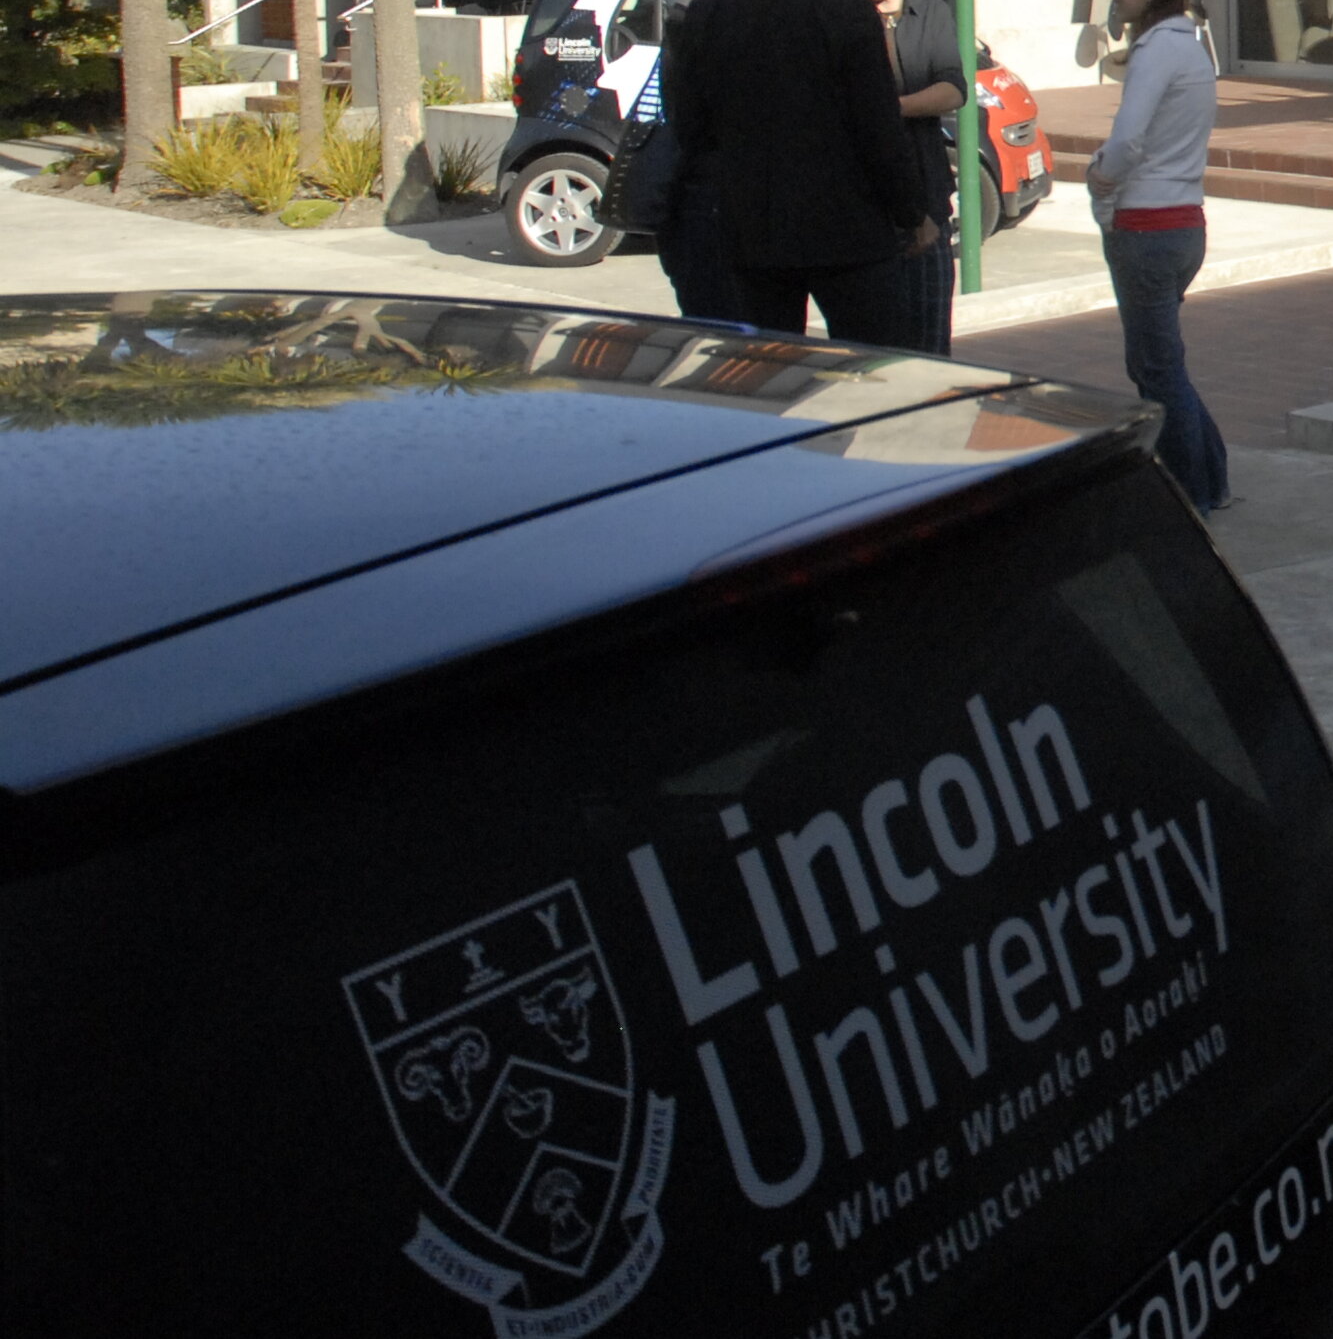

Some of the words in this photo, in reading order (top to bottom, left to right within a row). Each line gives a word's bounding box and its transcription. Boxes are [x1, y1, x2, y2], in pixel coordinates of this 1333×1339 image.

[558, 37, 592, 48] Lincoln
[558, 46, 602, 57] University
[629, 693, 1091, 1024] Lincoln
[695, 798, 1229, 1209] University
[760, 1239, 814, 1295] Te
[824, 1142, 952, 1252] Whare
[1100, 1027, 1118, 1061] o
[794, 1165, 1043, 1339] HRISTCHURCH
[1121, 1021, 1228, 1132] ZEALAND
